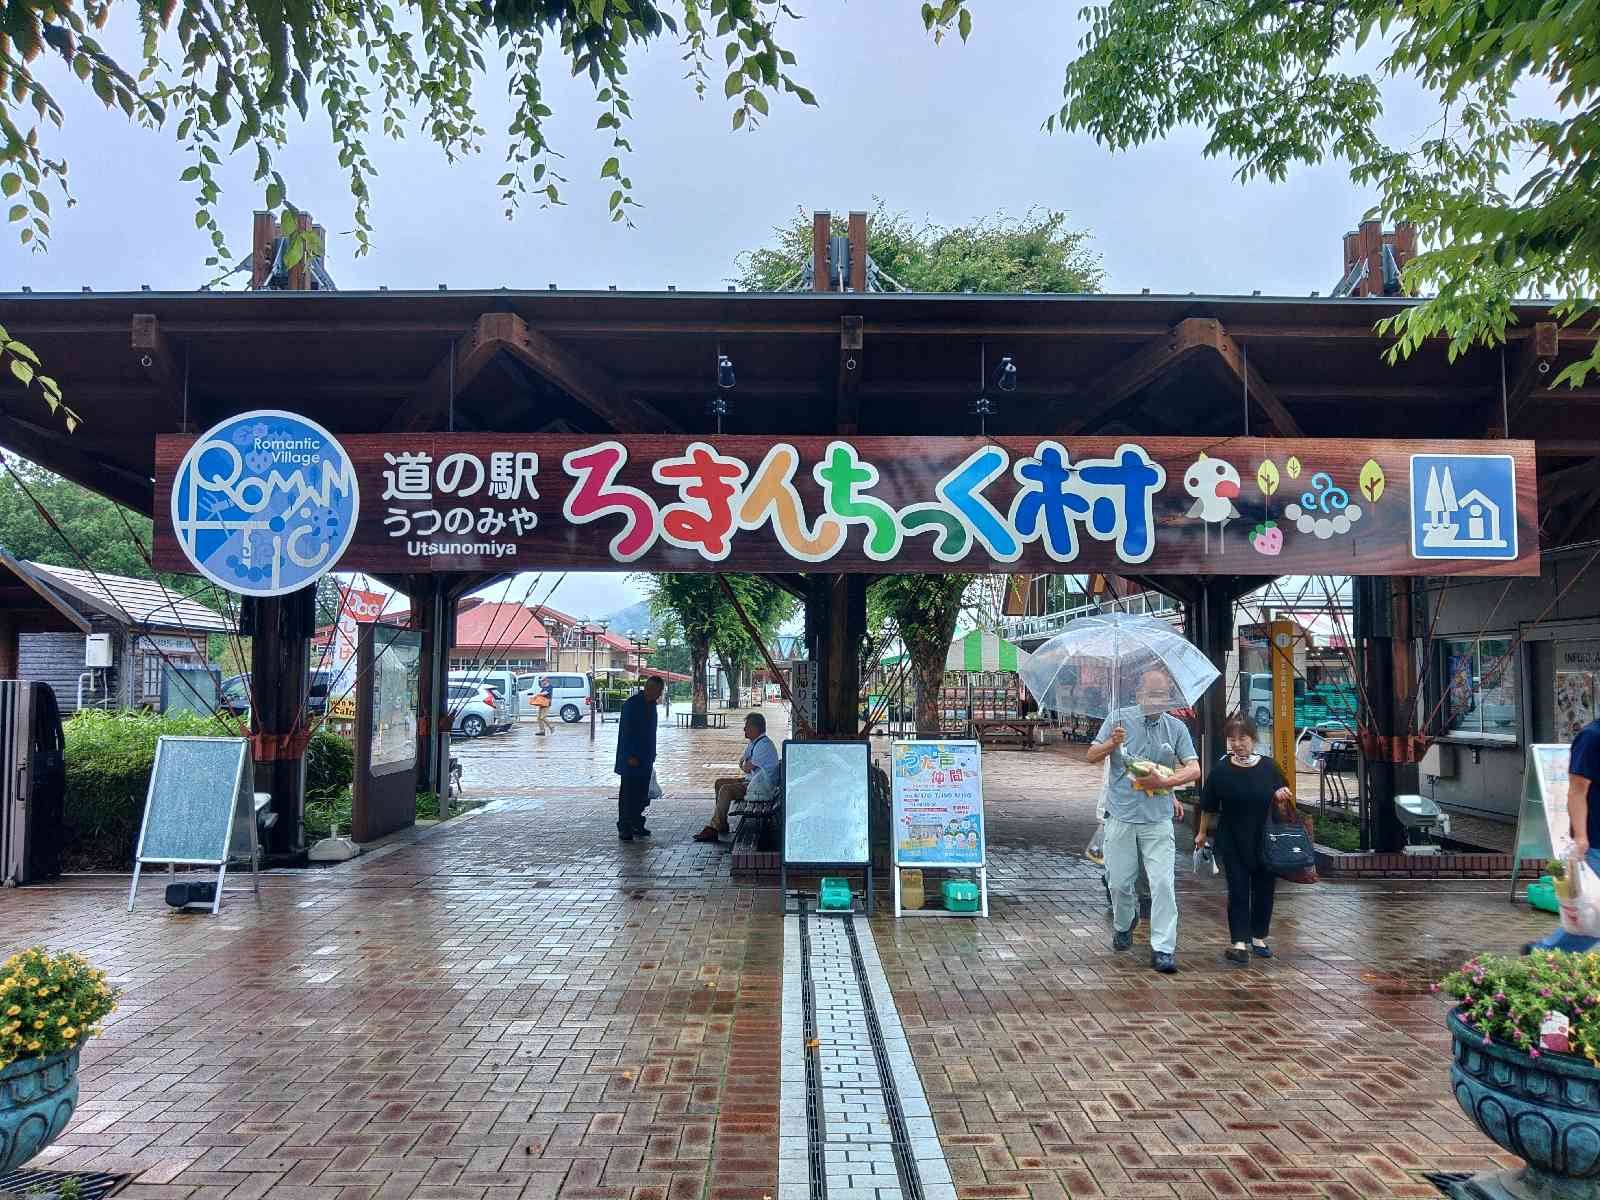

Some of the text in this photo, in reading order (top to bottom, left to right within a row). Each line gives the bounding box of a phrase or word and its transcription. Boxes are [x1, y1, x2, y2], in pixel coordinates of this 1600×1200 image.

[253, 438, 320, 450] Romantic
[271, 451, 320, 465] Village
[382, 452, 540, 500] 道の駅
[562, 441, 1166, 564] ろまんちっく村
[383, 507, 538, 537] うつのみや
[407, 540, 517, 558] Utsunomiya
[931, 768, 963, 784] 仲間
